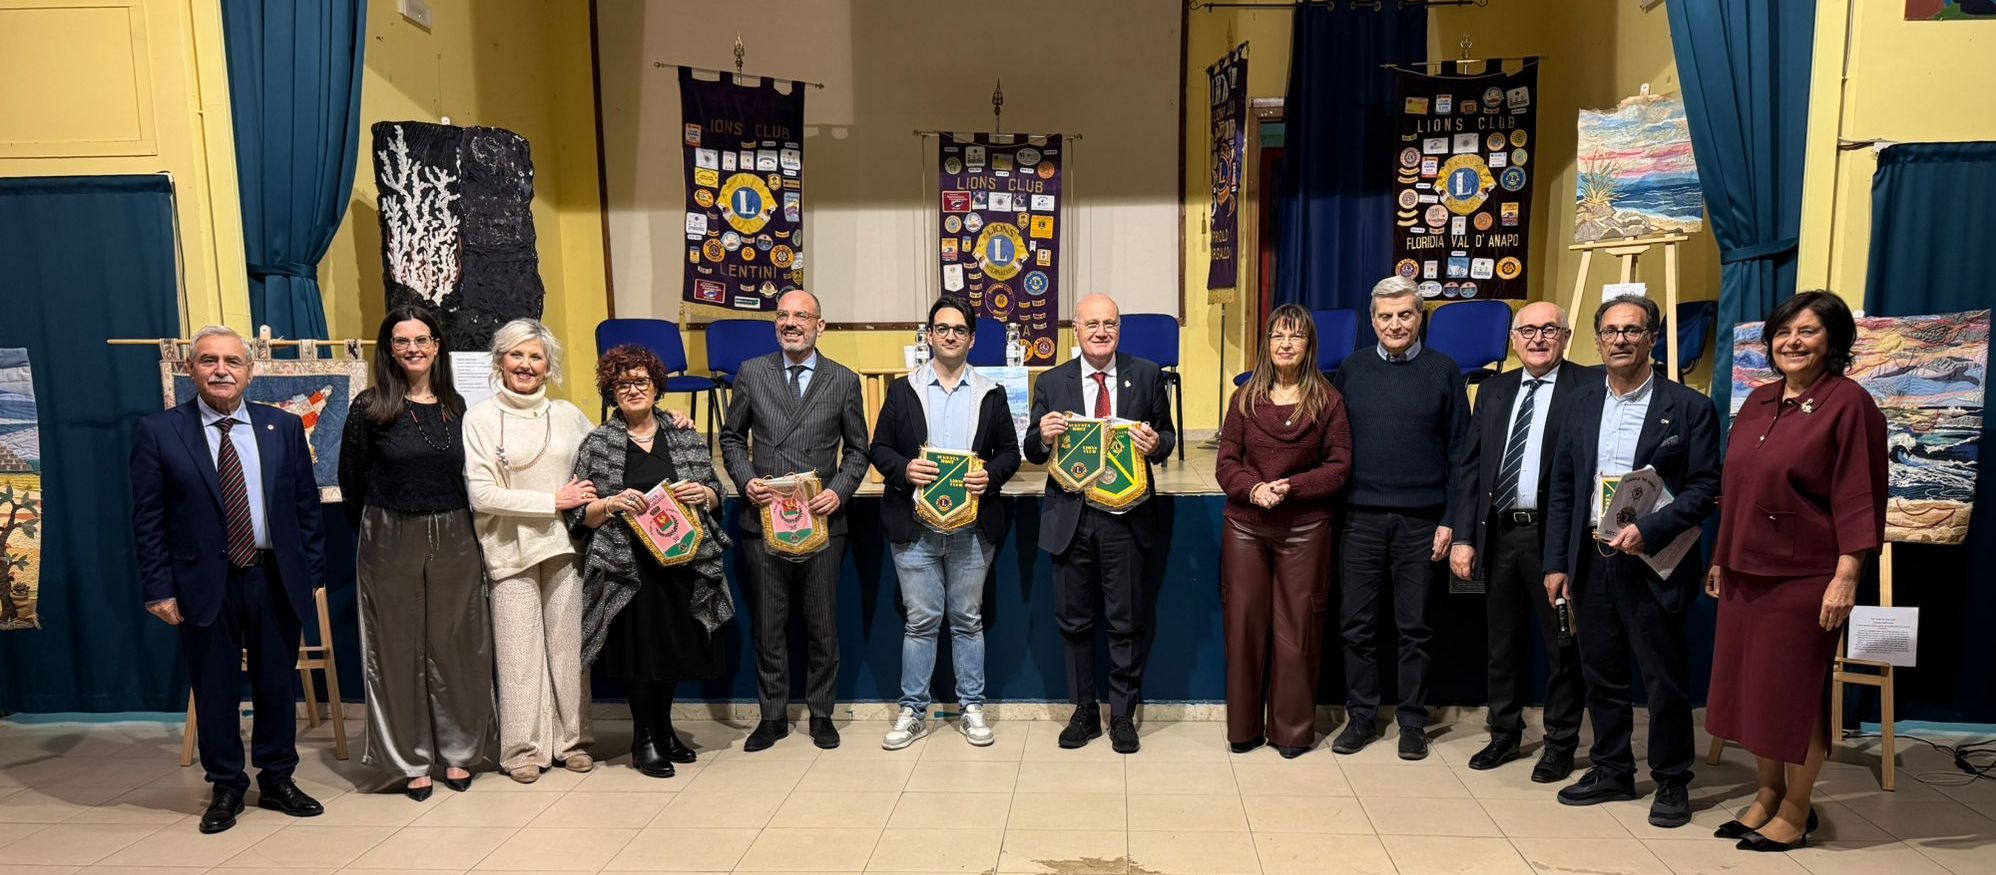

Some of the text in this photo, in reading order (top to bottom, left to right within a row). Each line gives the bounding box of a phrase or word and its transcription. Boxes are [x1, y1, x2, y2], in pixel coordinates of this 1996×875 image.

[755, 124, 790, 140] CLUB
[1417, 115, 1516, 133] LIONS CLUB
[956, 176, 1044, 194] LIONS CLUB
[1455, 171, 1473, 196] L
[738, 190, 756, 214] L
[986, 224, 1016, 237] LIONS
[993, 238, 1008, 262] L
[1406, 235, 1445, 250] FLORIDIA
[1451, 235, 1470, 248] VAL
[1487, 233, 1519, 248] ANAPO
[720, 263, 777, 279] LENTINI
